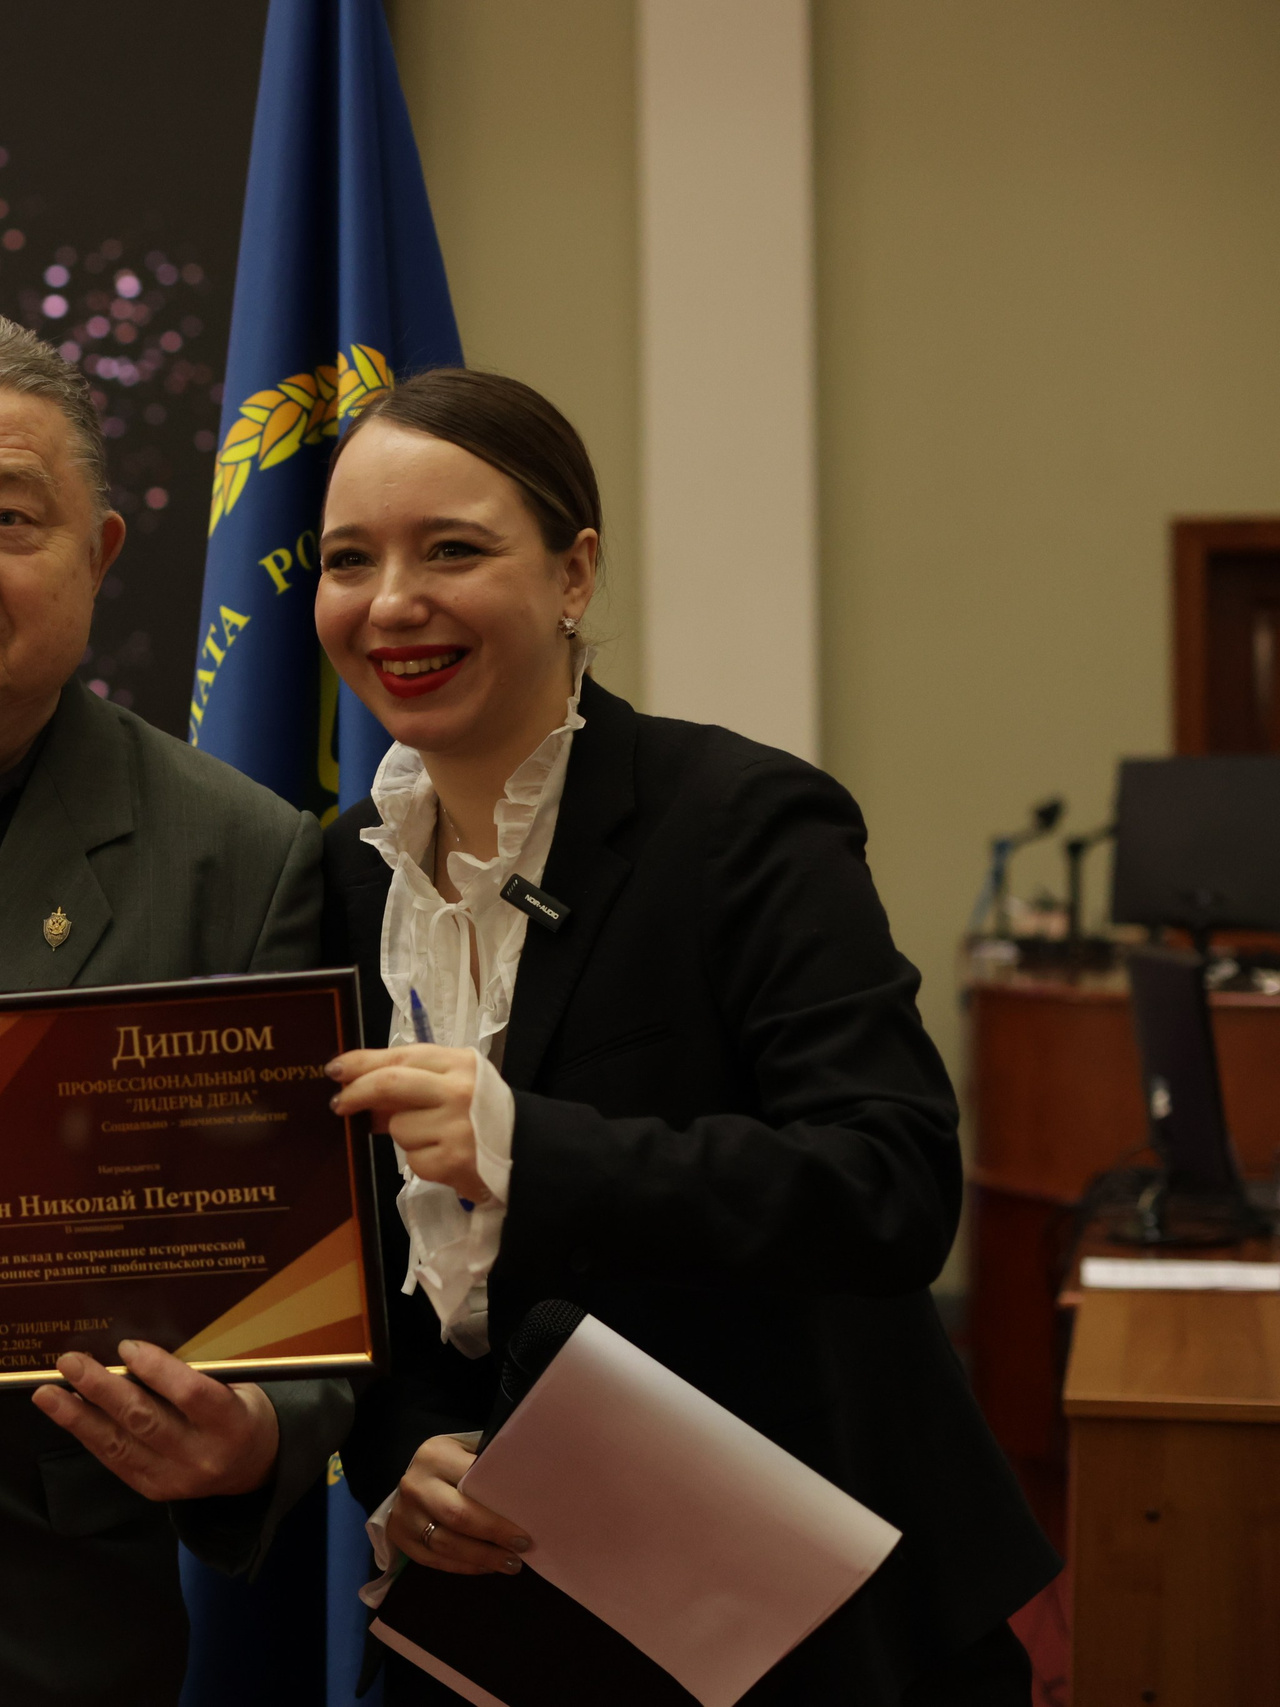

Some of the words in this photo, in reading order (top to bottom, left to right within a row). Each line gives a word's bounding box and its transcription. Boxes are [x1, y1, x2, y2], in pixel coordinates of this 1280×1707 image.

[113, 1024, 275, 1070] Диплом
[57, 1067, 256, 1096] ПРОФЕССИОНАЛЬНЫЙ
[126, 1094, 203, 1113] "ЛИДЕРЫ
[206, 1089, 259, 1110] ДЕЛА"
[19, 1189, 137, 1217] Николай
[143, 1184, 277, 1213] Петрович
[13, 1252, 53, 1267] вклад
[56, 1253, 64, 1262] в
[66, 1246, 146, 1263] сохранение
[150, 1238, 246, 1257] исторической
[44, 1264, 107, 1281] развитие
[110, 1256, 215, 1276] любительского
[218, 1253, 265, 1271] спорта
[11, 1319, 71, 1336] "ЛИДЕРЫ
[73, 1316, 113, 1332] ДЕЛА"
